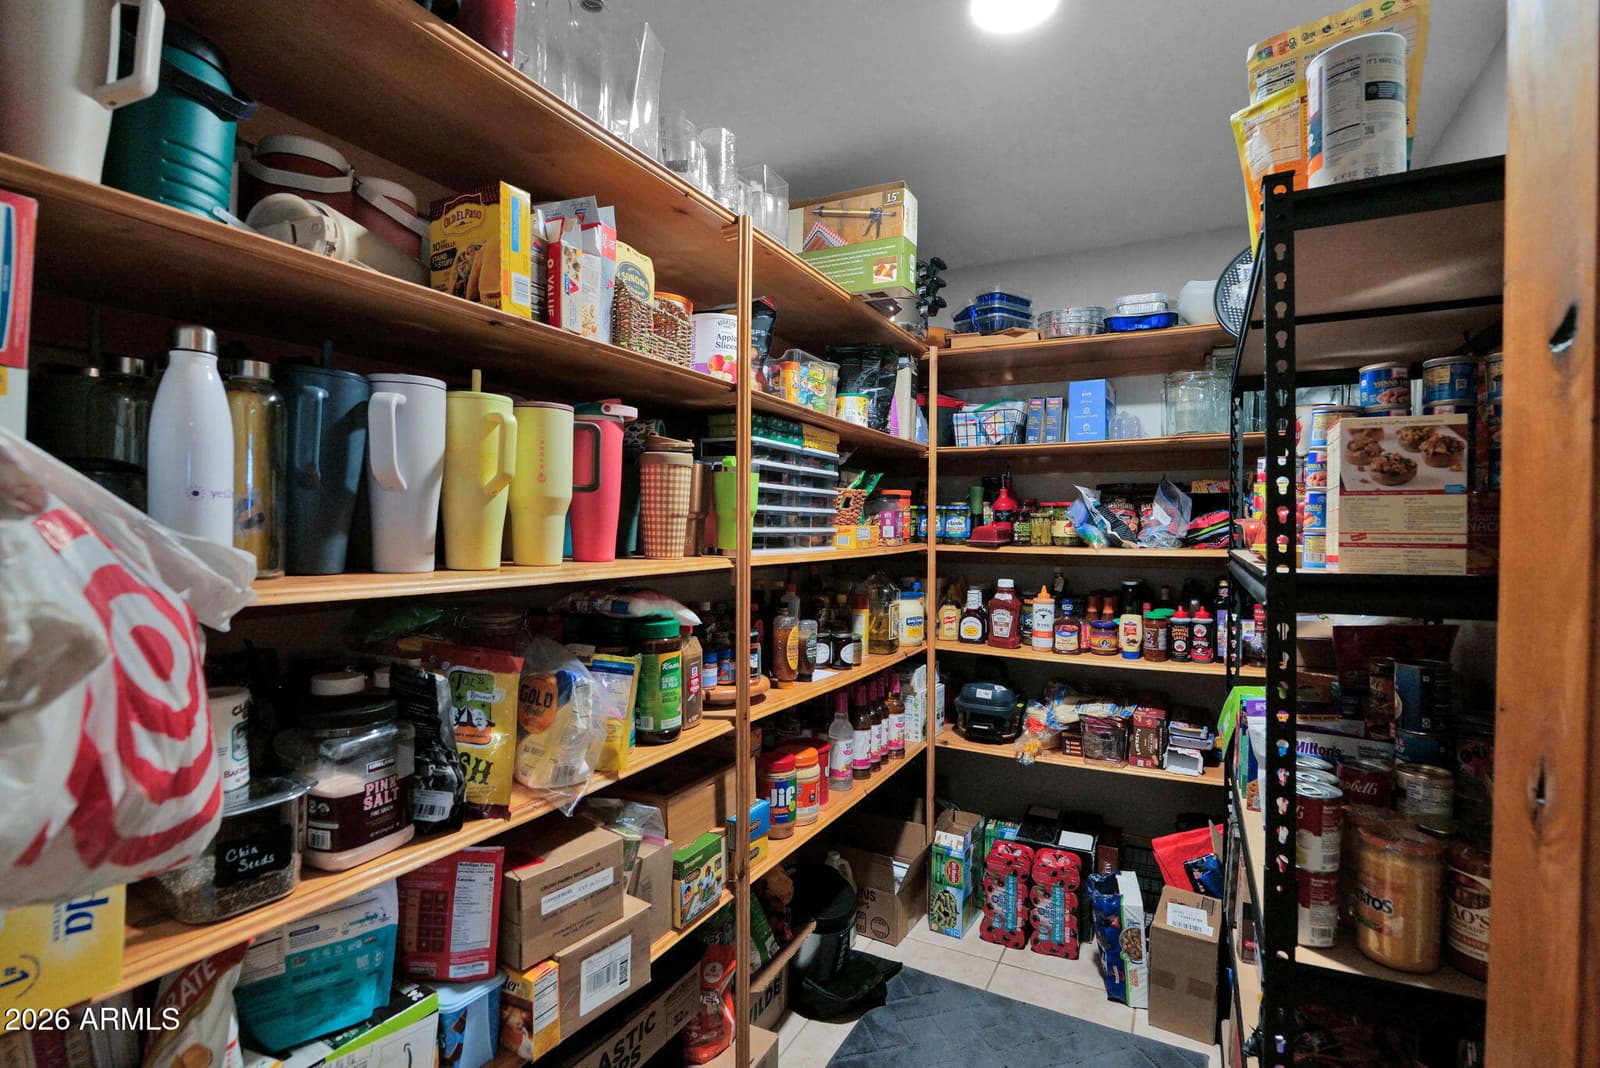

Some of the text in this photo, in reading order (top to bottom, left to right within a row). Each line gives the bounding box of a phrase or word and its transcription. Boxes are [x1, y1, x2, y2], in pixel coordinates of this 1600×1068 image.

[1279, 59, 1296, 70] Facts
[443, 208, 482, 229] OLD EL PASO
[520, 684, 553, 708] GOLD
[365, 774, 398, 796] PINK
[363, 787, 399, 811] SALT
[770, 786, 795, 807] Jif
[225, 845, 258, 864] Chia
[238, 853, 275, 873] Seeds
